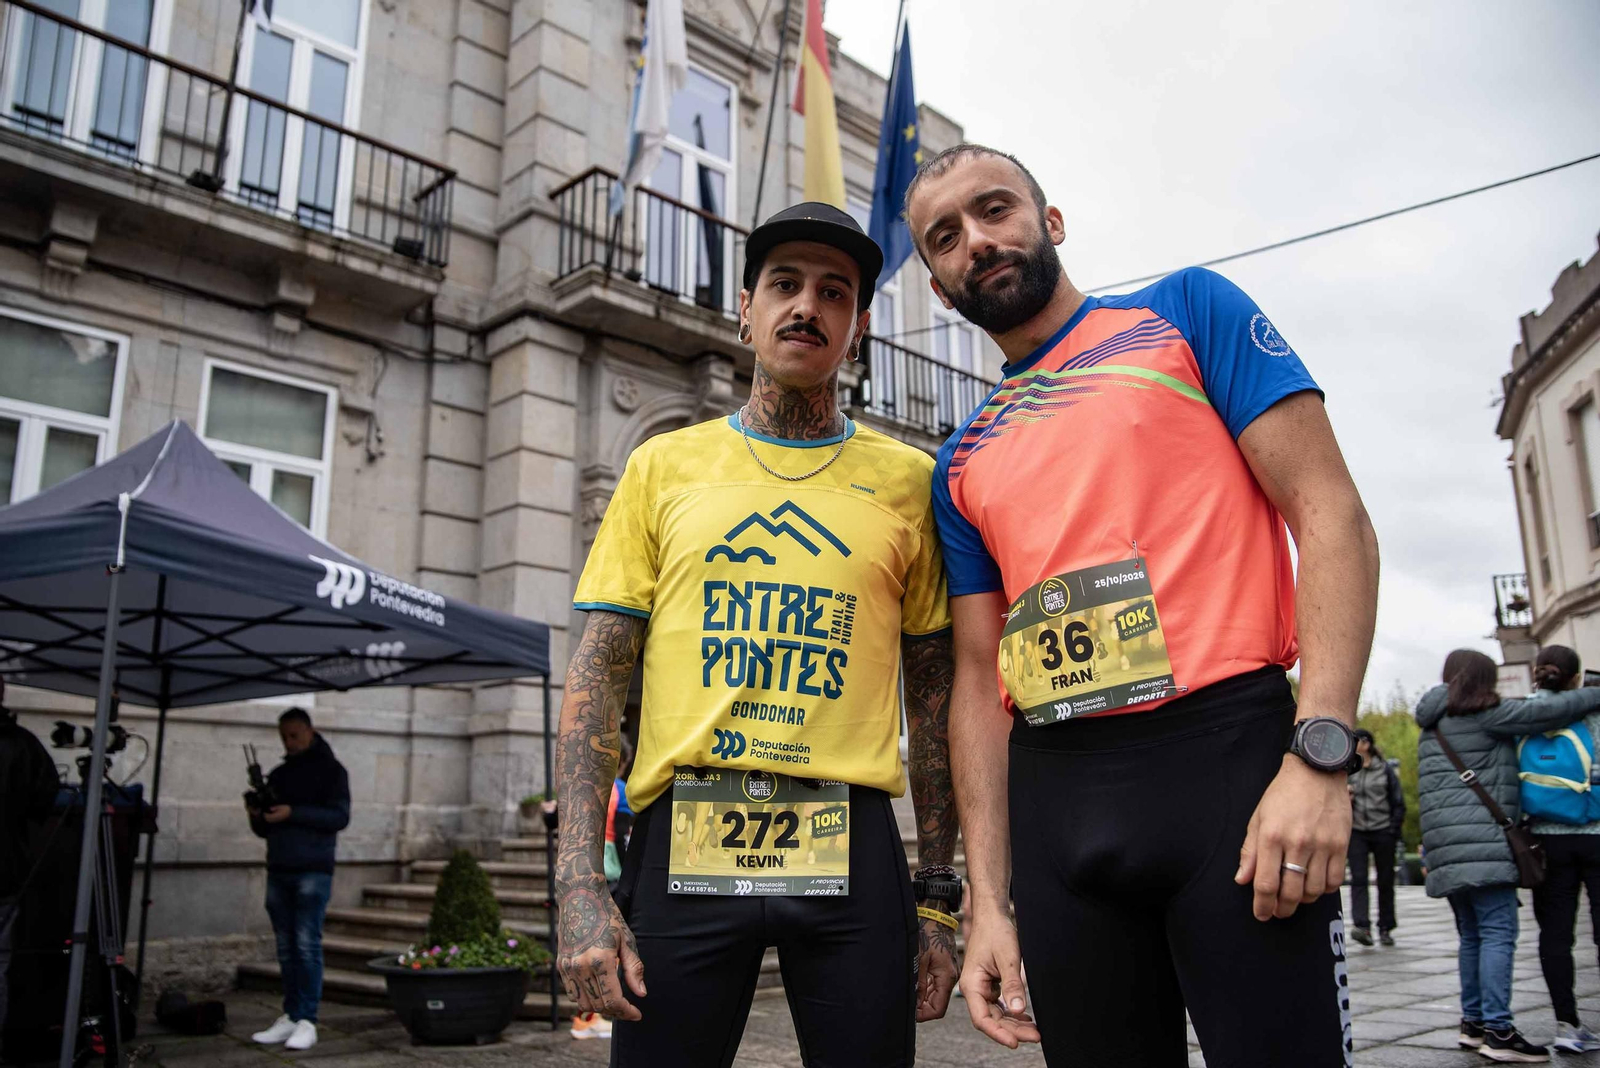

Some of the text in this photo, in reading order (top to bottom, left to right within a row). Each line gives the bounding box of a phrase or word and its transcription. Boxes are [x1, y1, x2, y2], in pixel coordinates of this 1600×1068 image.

[1094, 571, 1145, 588] 25/10/2026
[369, 571, 446, 609] Deputación
[370, 587, 446, 626] Pontevedra
[702, 580, 834, 640] ENTRE
[830, 592, 847, 641] TRAIL &
[841, 594, 858, 645] RUNNING
[1118, 606, 1152, 630] 10K
[1124, 622, 1153, 637] CARREIRA
[1038, 621, 1094, 671] 36
[701, 636, 848, 700] PONTES
[1051, 667, 1095, 691] FRAN
[1136, 679, 1169, 690] PROVINCIA
[1072, 695, 1106, 708] Deputación
[1127, 690, 1167, 705] DEPORTE
[730, 701, 806, 726] GONDOMAR
[1074, 702, 1107, 713] Pontevedra
[751, 737, 811, 754] Deputación
[749, 749, 810, 765] Pontevedra
[715, 773, 721, 781] 3
[749, 788, 771, 796] PONTES
[814, 811, 843, 829] 10K
[722, 810, 800, 850] 272
[817, 826, 843, 835] CARREIRA
[736, 855, 784, 869] KEVIN
